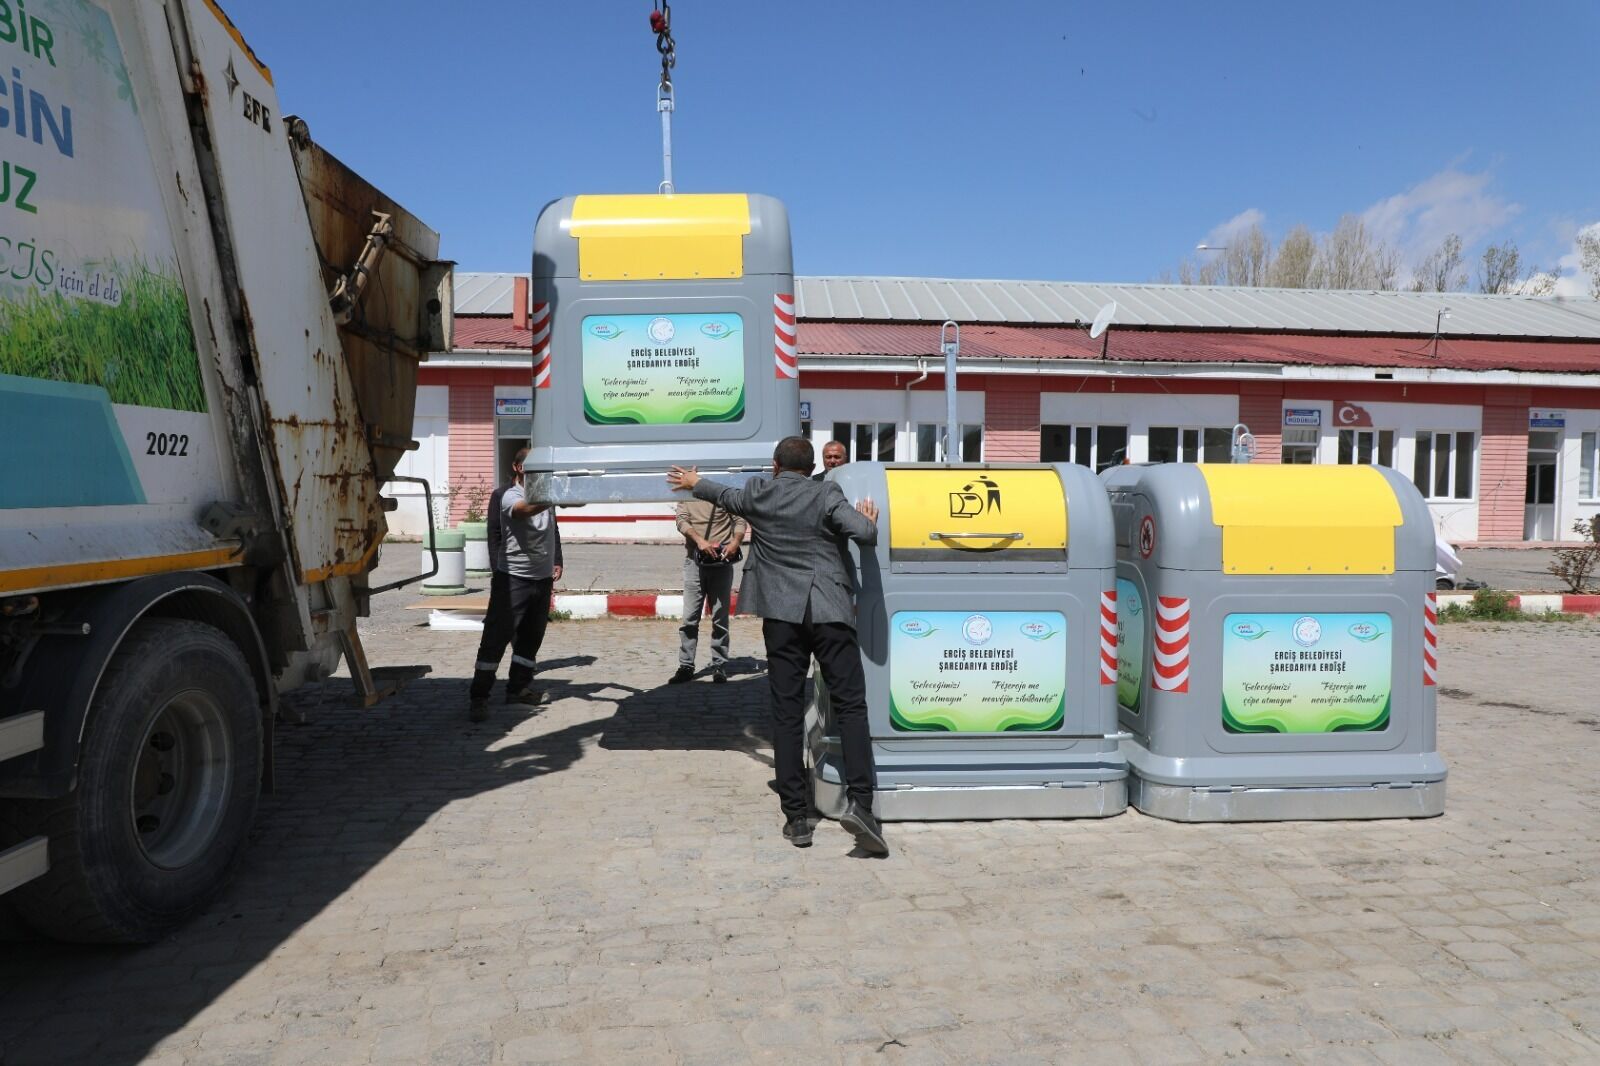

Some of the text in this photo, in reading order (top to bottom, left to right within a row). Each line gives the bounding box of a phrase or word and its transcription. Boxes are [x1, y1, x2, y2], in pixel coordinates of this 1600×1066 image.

[243, 91, 271, 134] EFE
[60, 267, 84, 295] için
[89, 273, 100, 297] el
[103, 278, 119, 302] ele
[631, 347, 695, 358] ERCİŞ BELEDİYESİ
[146, 431, 189, 456] 2022
[944, 648, 1013, 661] ERCİŞ BELEDİYESİ
[1275, 650, 1341, 662] ERCİŞ BELEDİYESİ
